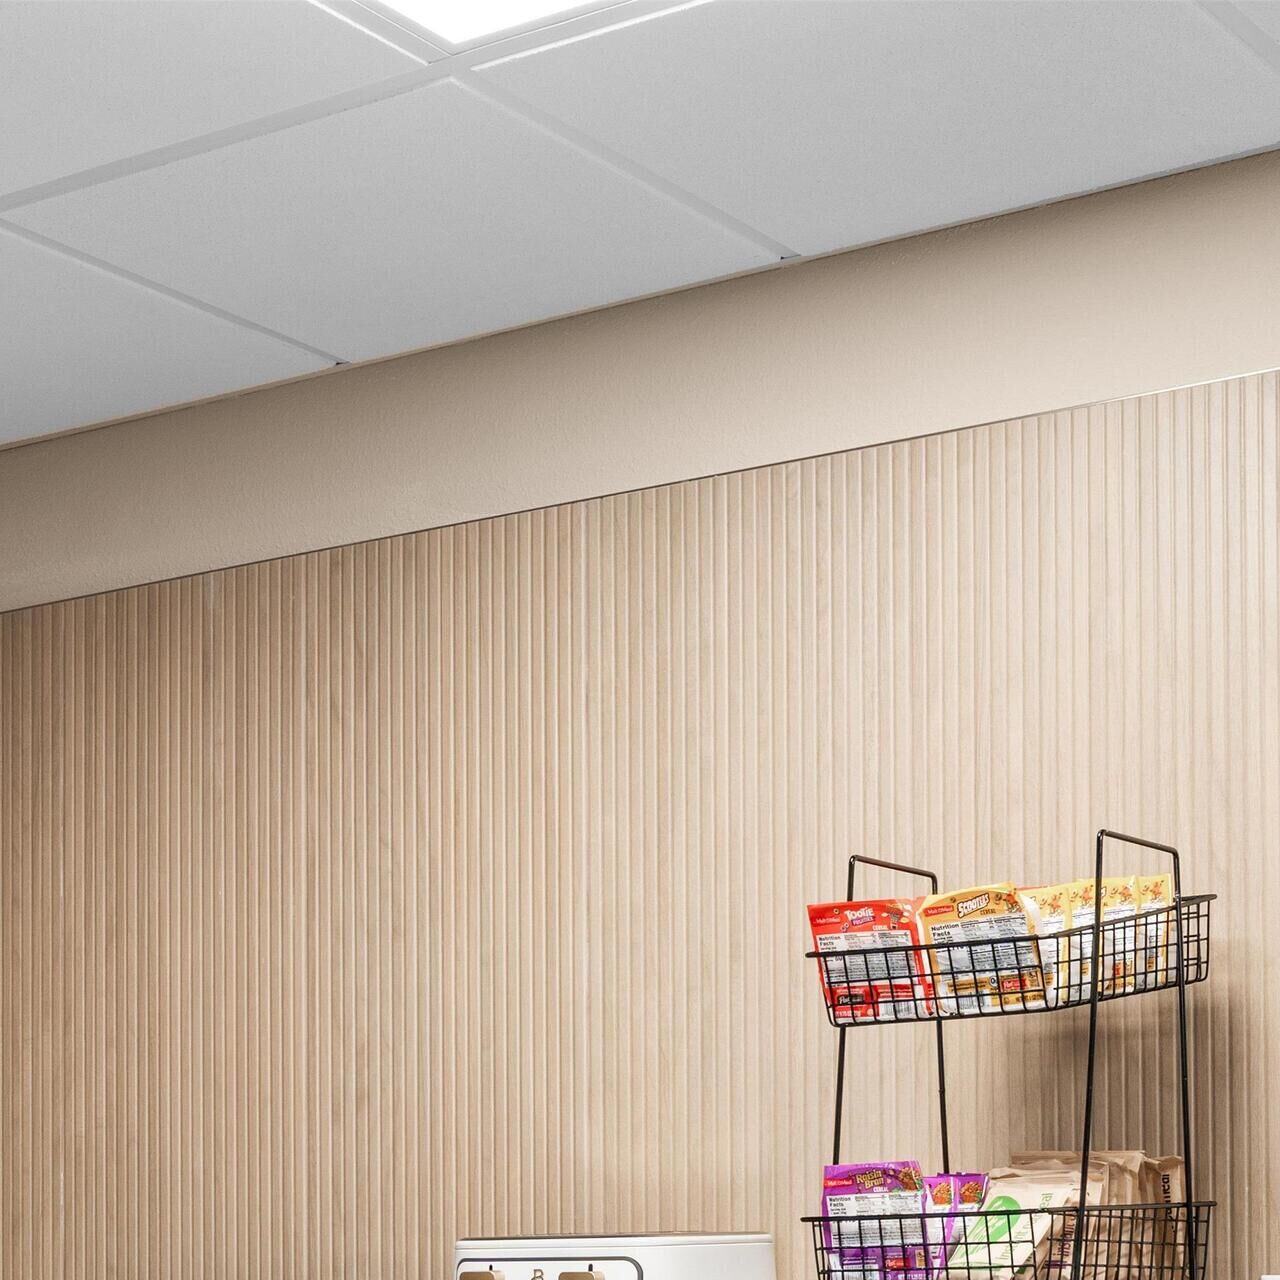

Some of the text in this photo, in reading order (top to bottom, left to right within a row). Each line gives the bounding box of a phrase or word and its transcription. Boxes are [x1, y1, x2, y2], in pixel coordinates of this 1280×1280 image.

[957, 893, 990, 918] SCOOTERS
[844, 907, 875, 920] TOOTIE
[931, 923, 960, 932] Nutrition
[856, 1169, 882, 1184] Raisin
[864, 1177, 885, 1189] Bran
